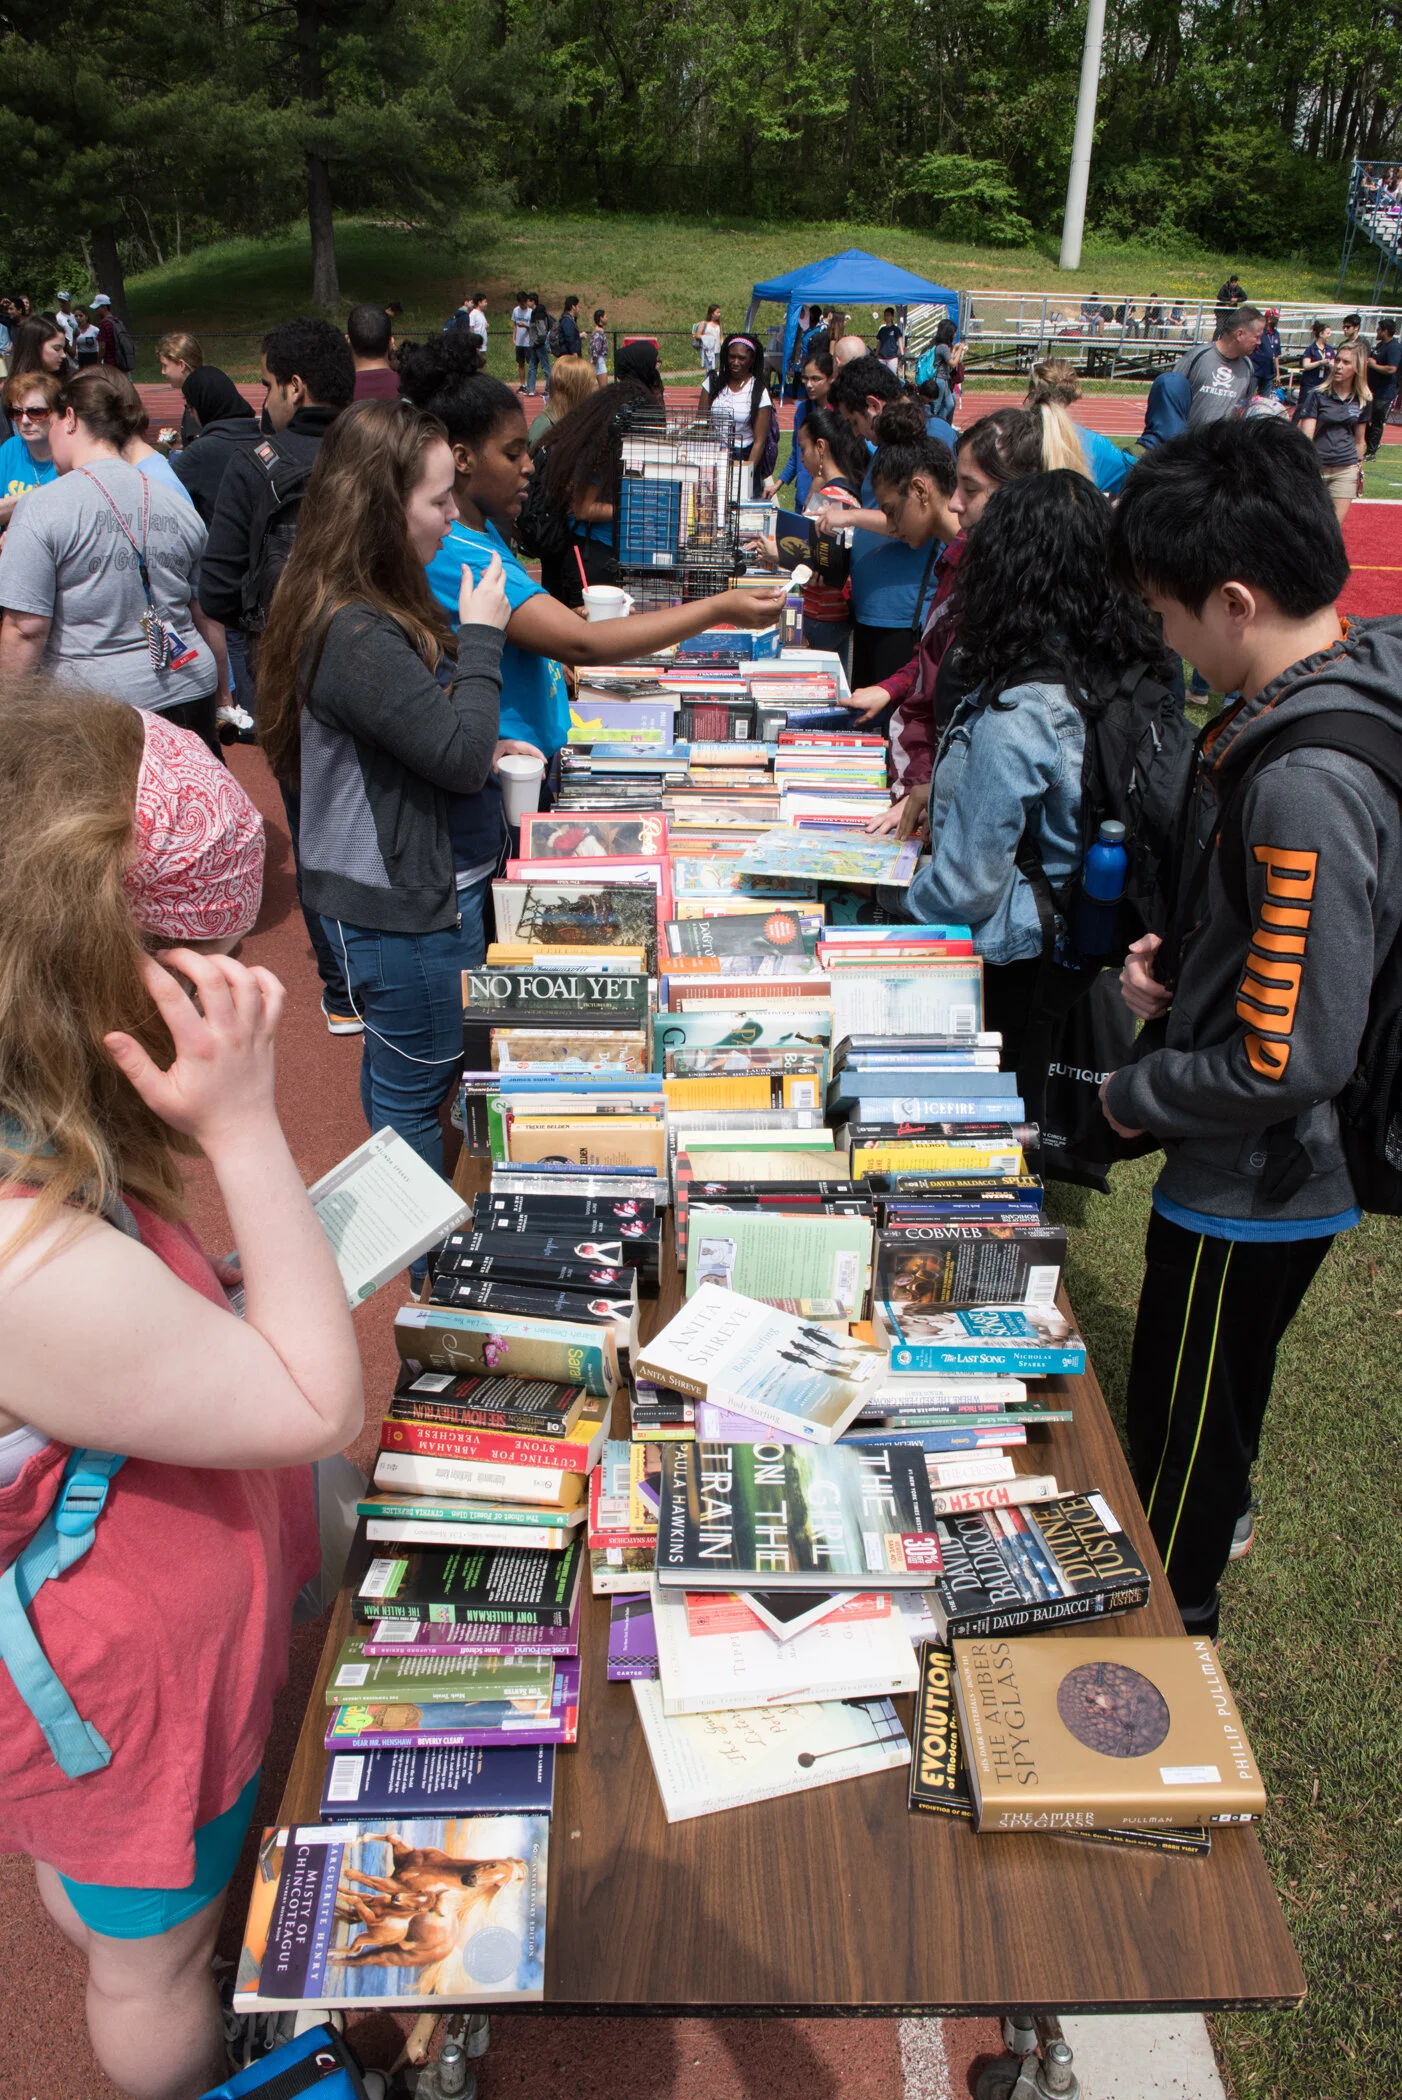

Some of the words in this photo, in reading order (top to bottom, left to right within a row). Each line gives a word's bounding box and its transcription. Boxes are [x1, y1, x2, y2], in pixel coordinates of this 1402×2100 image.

[1200, 385, 1237, 398] ATHLETICS
[96, 510, 132, 538] Play
[114, 547, 138, 571] Go
[469, 976, 512, 998] NO
[518, 976, 585, 999] FOAL
[587, 977, 639, 1000] YET
[496, 1102, 506, 1110] 2
[924, 1102, 976, 1115] ICEFIRE
[438, 1214, 465, 1237] SPEAK
[906, 1228, 982, 1239] COBWEB
[470, 1233, 478, 1251] MEYER
[480, 1256, 489, 1273] MEYER
[478, 1282, 488, 1302] MEYER
[668, 1303, 721, 1352] ANITA
[980, 1312, 1011, 1336] SONG
[687, 1308, 751, 1367] SHREVE
[752, 1327, 780, 1357] Surfing
[568, 1347, 583, 1382] Sarah
[941, 1354, 956, 1362] The
[957, 1354, 978, 1363] LAST
[980, 1354, 1005, 1363] SONG
[1014, 1352, 1052, 1360] NICHOLAS
[639, 1365, 667, 1383] ANITA
[668, 1376, 702, 1395] SHREVE
[413, 1403, 433, 1419] RUN
[434, 1406, 459, 1423] THEY
[461, 1409, 486, 1426] HOW
[958, 1405, 976, 1413] Thicker
[487, 1413, 506, 1428] SEE
[508, 1414, 545, 1425] PATTERSON
[416, 1428, 480, 1444] VERGHESE
[418, 1440, 477, 1455] ABRAHAM
[491, 1449, 515, 1460] FOR
[514, 1440, 555, 1453] STONE
[519, 1453, 576, 1467] CUTTING
[672, 1444, 688, 1489] PAULA
[752, 1443, 785, 1485] ON
[858, 1450, 897, 1517] THE
[698, 1448, 733, 1560] TRAIN
[949, 1487, 1011, 1511] HITCH
[382, 1507, 414, 1516] DEFELICE
[415, 1509, 443, 1518] CYNTHIA
[451, 1510, 468, 1518] Glen
[469, 1511, 493, 1520] Fossil
[912, 1501, 921, 1516] TIMES
[504, 1513, 524, 1522] Ghost
[526, 1515, 539, 1523] The
[807, 1479, 845, 1566] GIRL
[668, 1494, 686, 1563] HAWKINS
[754, 1500, 790, 1573] THE
[1032, 1507, 1097, 1582] DIVINE
[1059, 1496, 1142, 1580] JUSTICE
[903, 1538, 939, 1564] 30%
[955, 1513, 1022, 1604] BALDACCI
[938, 1537, 983, 1592] DAVID
[1109, 1594, 1142, 1609] JUSTICE
[1112, 1587, 1141, 1600] DIVINE
[364, 1605, 380, 1615] MAN
[382, 1606, 405, 1616] FALLEN
[407, 1606, 420, 1617] THE
[467, 1610, 514, 1623] HILLERMAN
[515, 1611, 538, 1623] TONY
[993, 1611, 1030, 1629] DAVID
[1033, 1599, 1090, 1621] BALDACCI
[485, 1647, 501, 1655] Anne
[515, 1646, 540, 1655] Found
[551, 1646, 569, 1654] Lost
[964, 1666, 974, 1687] BOOK
[972, 1643, 1002, 1725] AMBER
[1193, 1641, 1234, 1718] PULLMAN
[504, 1688, 527, 1696] SAWYER
[920, 1652, 952, 1787] EVOLUTION
[970, 1694, 983, 1740] MATERIALS
[990, 1642, 1039, 1785] SPYGLASS
[352, 1738, 369, 1746] DEAR
[370, 1738, 382, 1746] MR.
[382, 1737, 412, 1746] HENSHAW
[417, 1737, 441, 1745] BEVERLY
[441, 1736, 464, 1745] CLEARY
[979, 1741, 988, 1757] DARK
[947, 1731, 958, 1774] Modern
[989, 1735, 1012, 1785] THE
[1223, 1725, 1253, 1781] PHILIP
[948, 1776, 954, 1790] of
[919, 1804, 950, 1814] EVOLUTION
[1002, 1812, 1038, 1820] THE
[1041, 1812, 1095, 1820] AMBER
[999, 1819, 1095, 1828] SPYGLASS
[281, 1878, 291, 1905] NEWBERY
[301, 1870, 319, 1918] MISTY
[529, 1863, 538, 1923] ANNIVERSARY
[277, 1845, 311, 1973] CHINCOTEAGUE
[278, 1906, 286, 1922] HONOR
[275, 1924, 283, 1942] BOOK
[296, 1922, 307, 1945] OF
[528, 1924, 536, 1959] EDITION
[310, 1932, 325, 1981] HENRY
